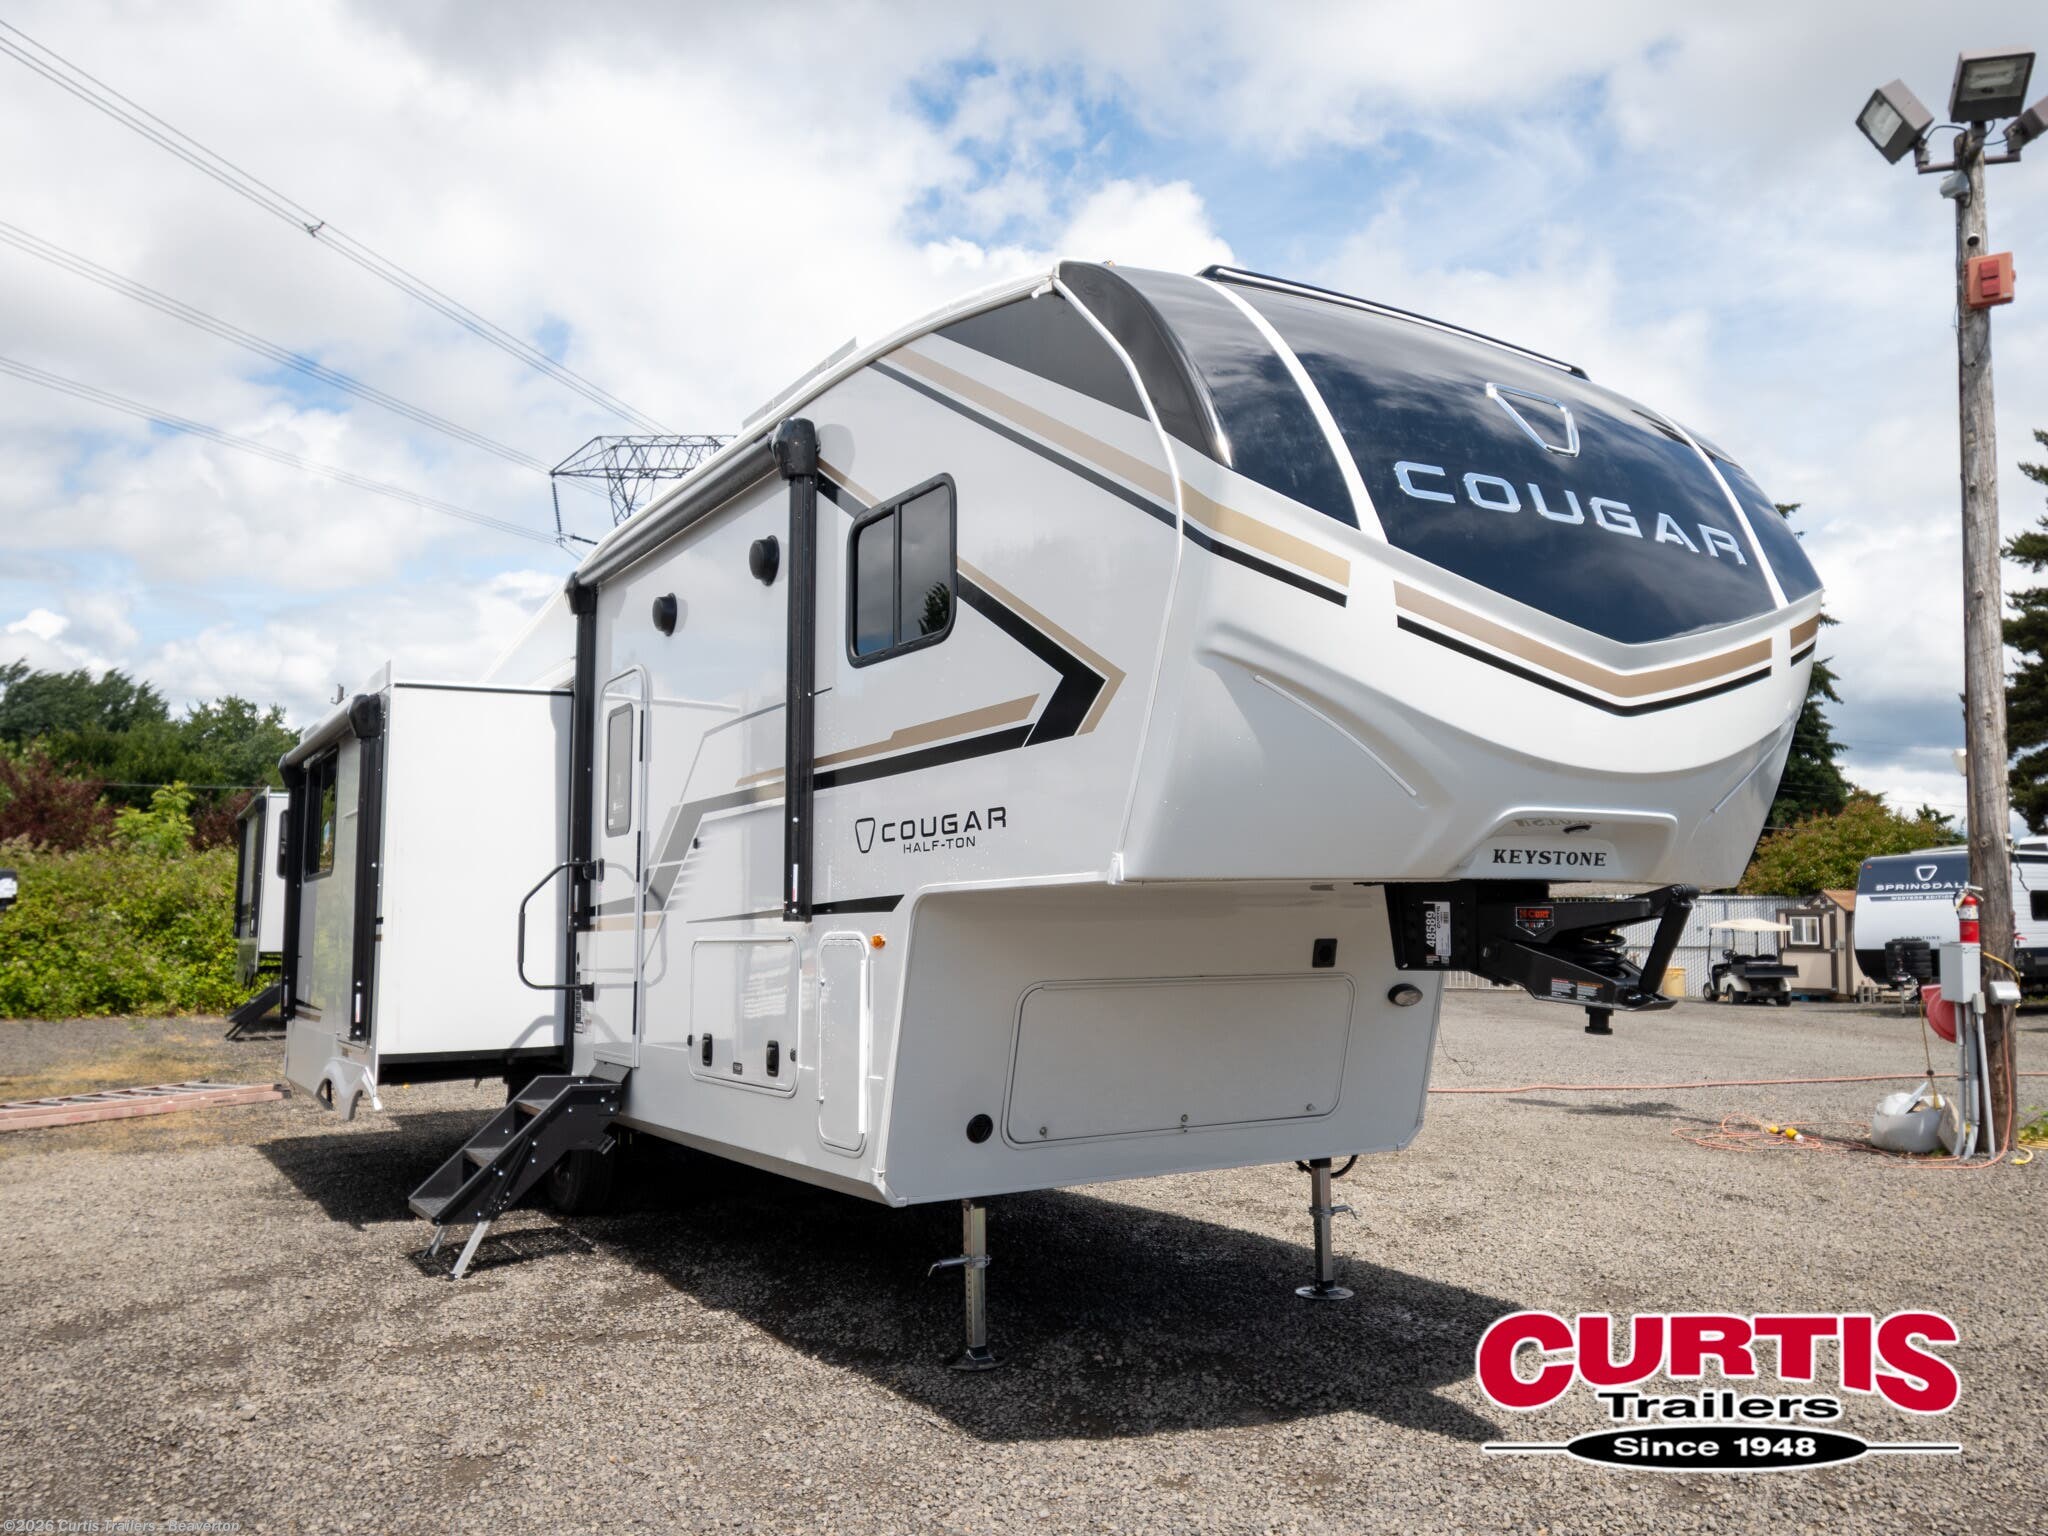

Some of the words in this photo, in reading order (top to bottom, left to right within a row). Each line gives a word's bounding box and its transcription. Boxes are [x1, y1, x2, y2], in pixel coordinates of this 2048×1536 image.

[1394, 460, 1747, 565] COUGAR
[881, 806, 1007, 843] COUGAR
[903, 836, 976, 854] HALF-TON
[1492, 848, 1608, 867] KEYSTONE
[1425, 910, 1437, 948] 48589
